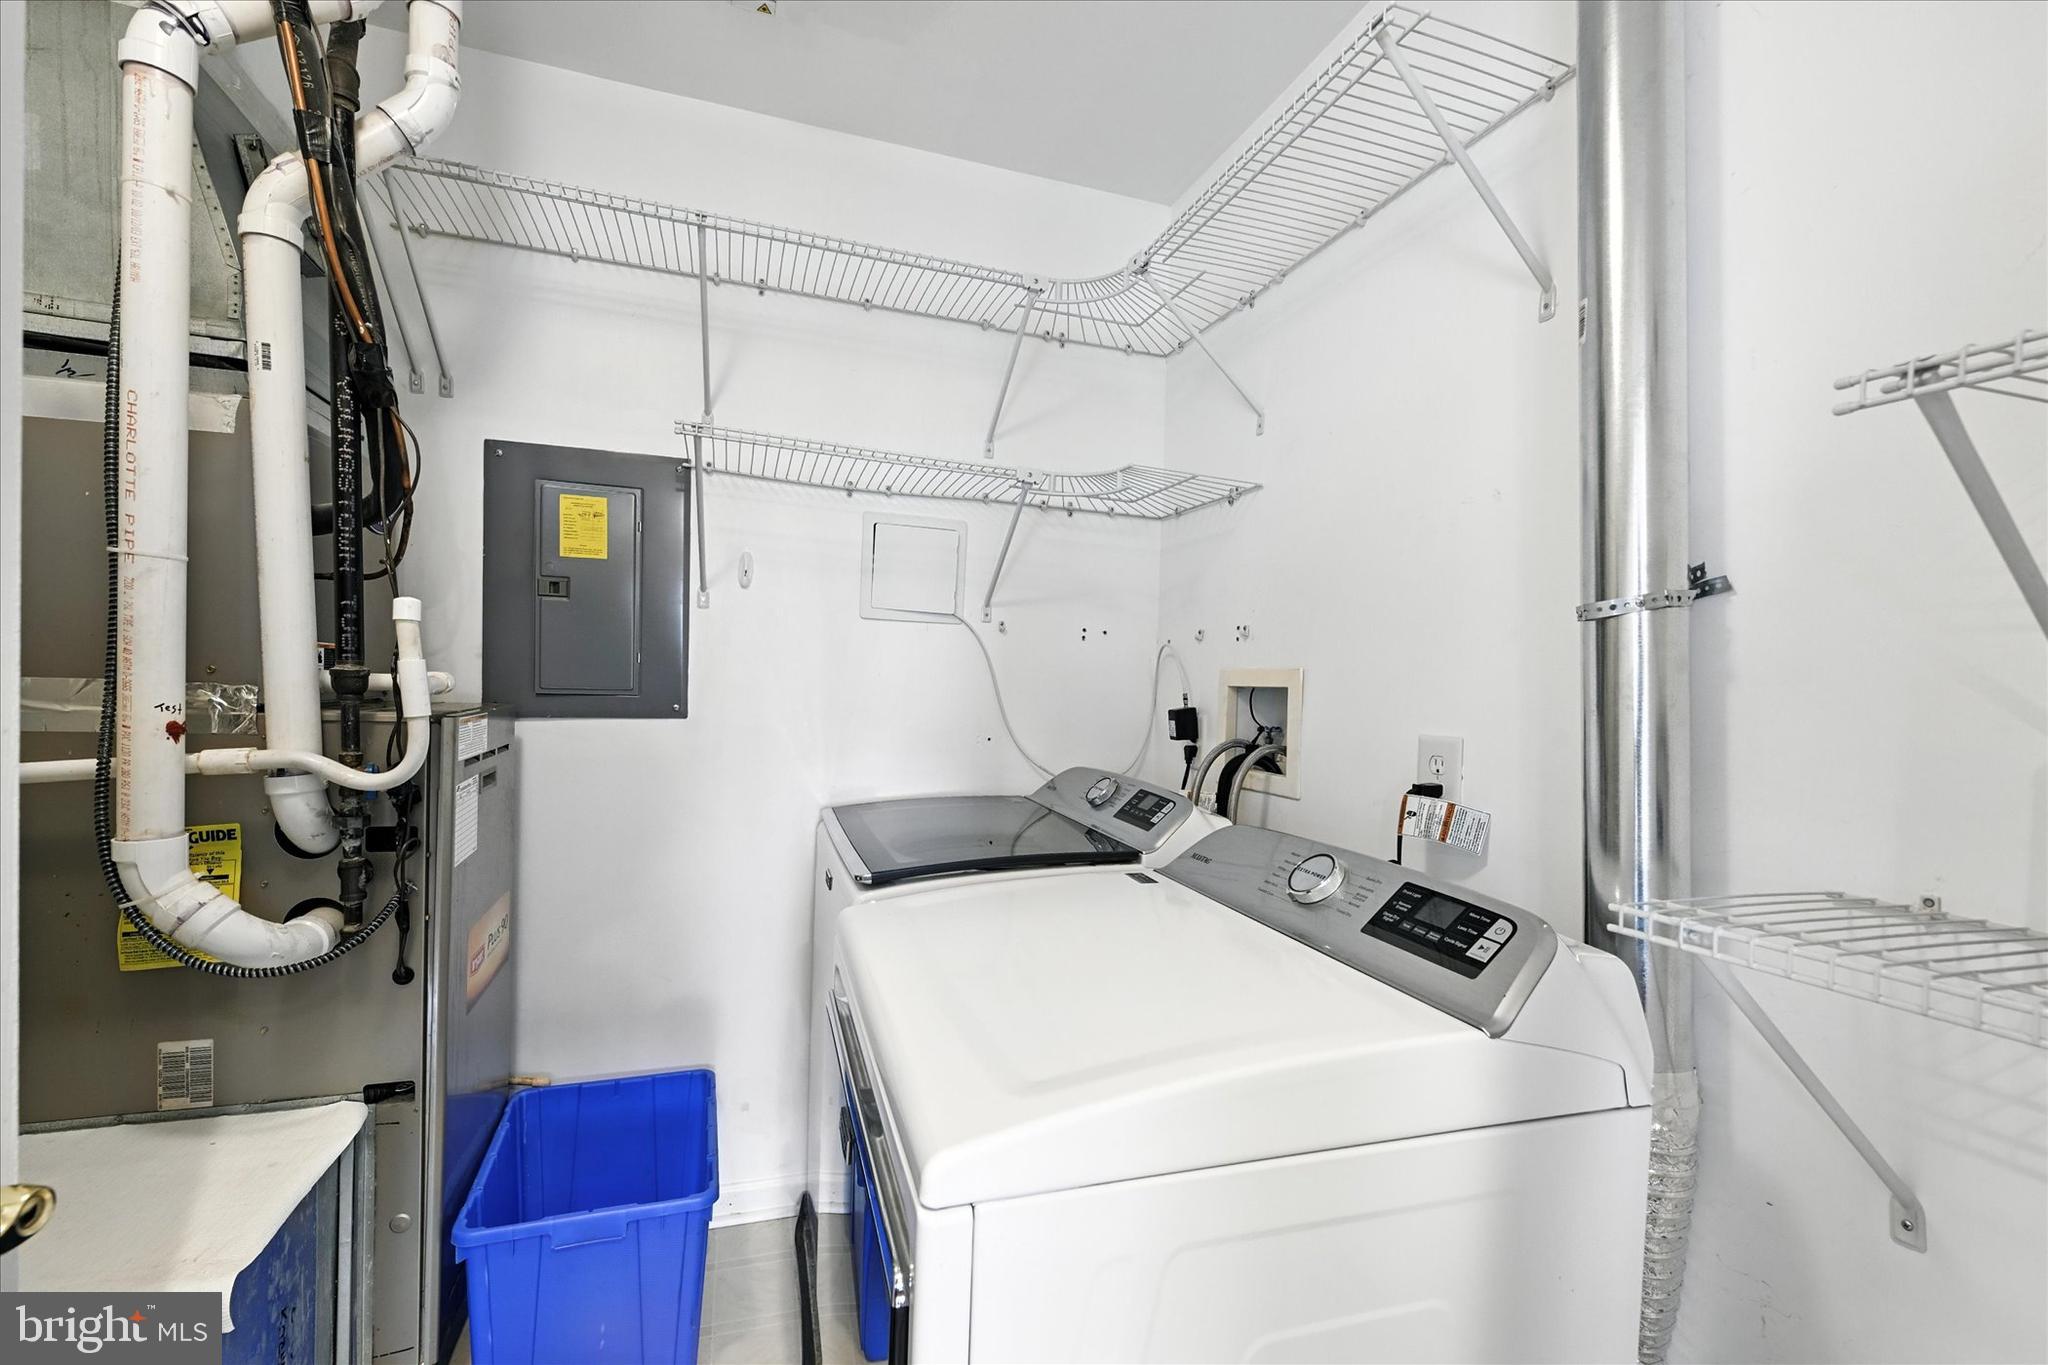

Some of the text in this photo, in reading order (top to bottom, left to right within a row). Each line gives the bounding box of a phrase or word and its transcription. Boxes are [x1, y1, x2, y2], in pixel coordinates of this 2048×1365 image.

[125, 389, 138, 502] CHARLOTTE
[123, 513, 135, 564] PIPE
[154, 703, 183, 714] Test
[188, 829, 237, 844] GUIDE
[1310, 871, 1327, 880] POWER
